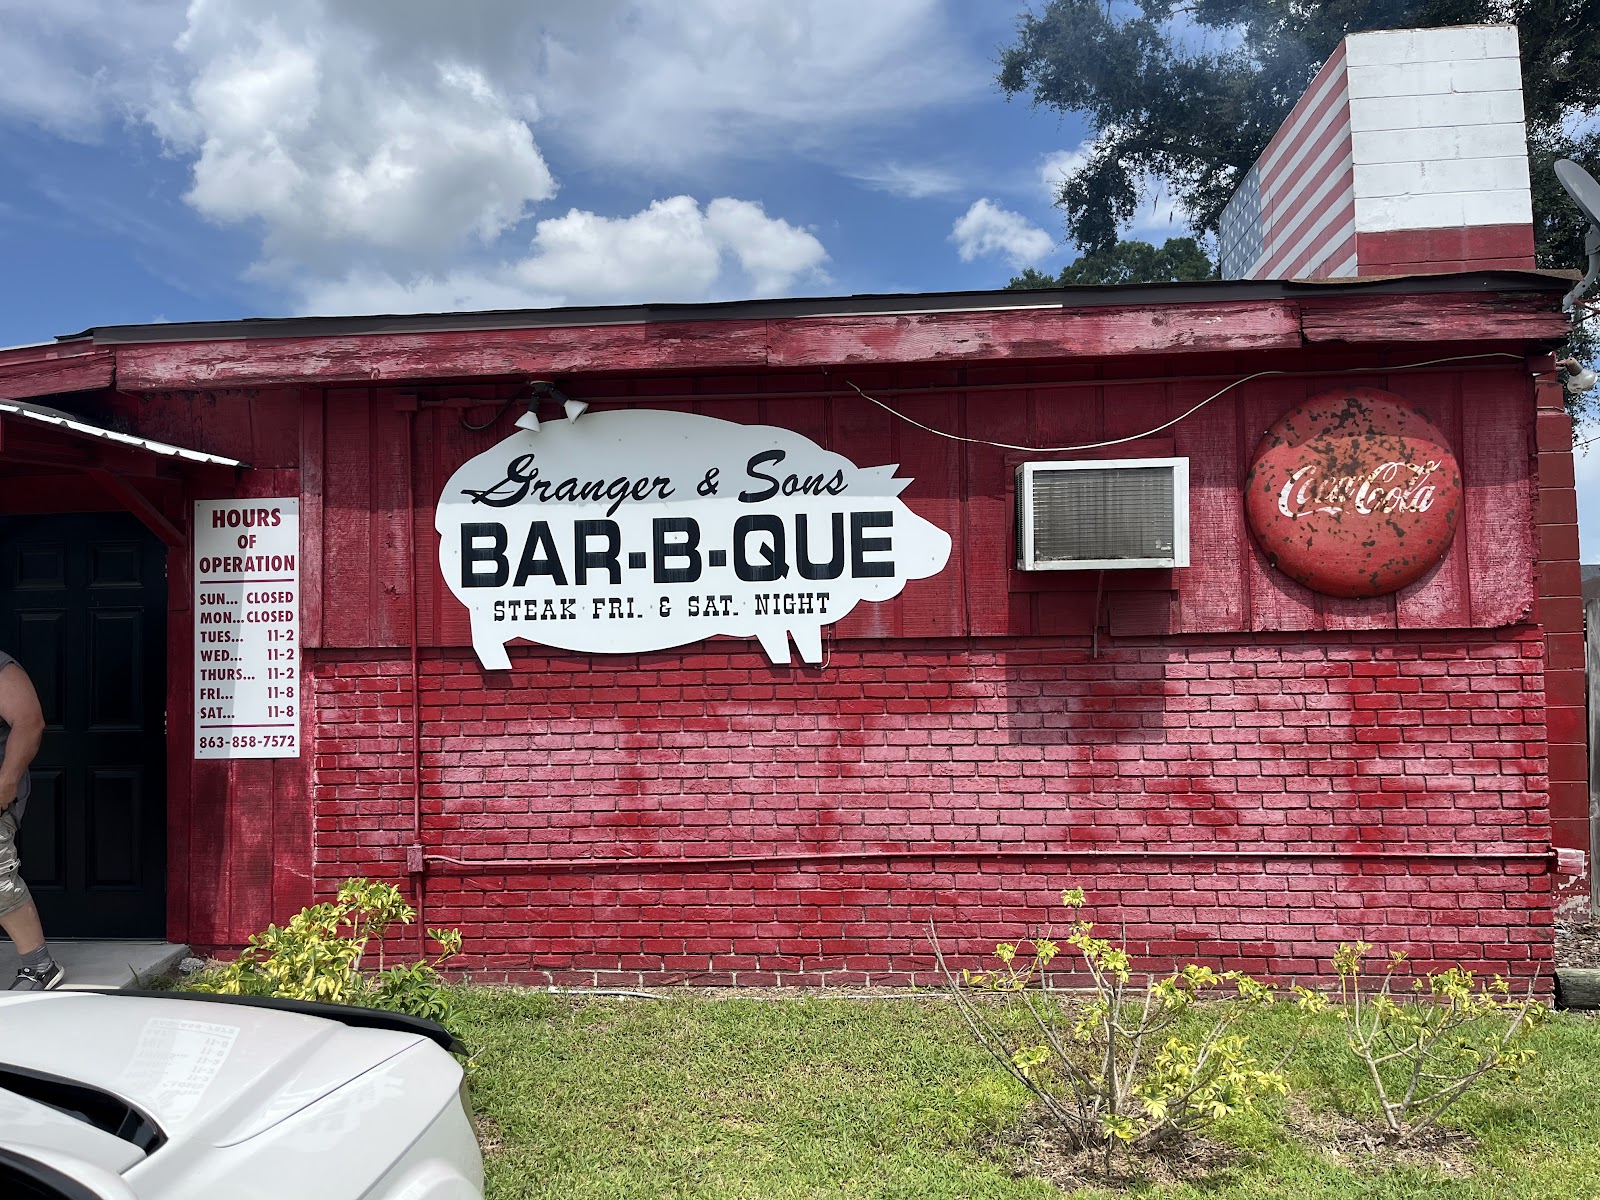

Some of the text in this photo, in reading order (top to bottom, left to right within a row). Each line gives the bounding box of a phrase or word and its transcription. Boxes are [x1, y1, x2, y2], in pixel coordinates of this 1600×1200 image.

[461, 449, 849, 518] Granger & Sons
[212, 508, 281, 528] HOURS
[237, 534, 257, 549] OF
[461, 511, 895, 588] BAR-B-QUE
[199, 555, 295, 573] OPERATION
[200, 591, 294, 605] SUN... CLOSED
[494, 592, 830, 622] STEAK FRI. & SAT. NIGHT
[246, 610, 294, 623] CLOSED
[200, 629, 294, 643] TUES... 11-2
[200, 648, 294, 662] WED... 11-2
[200, 667, 294, 681] THURS... 11-2
[200, 686, 294, 700] FRI... 11-8
[200, 705, 294, 719] SAT... 11-8
[199, 735, 295, 749] 863-858-7572
